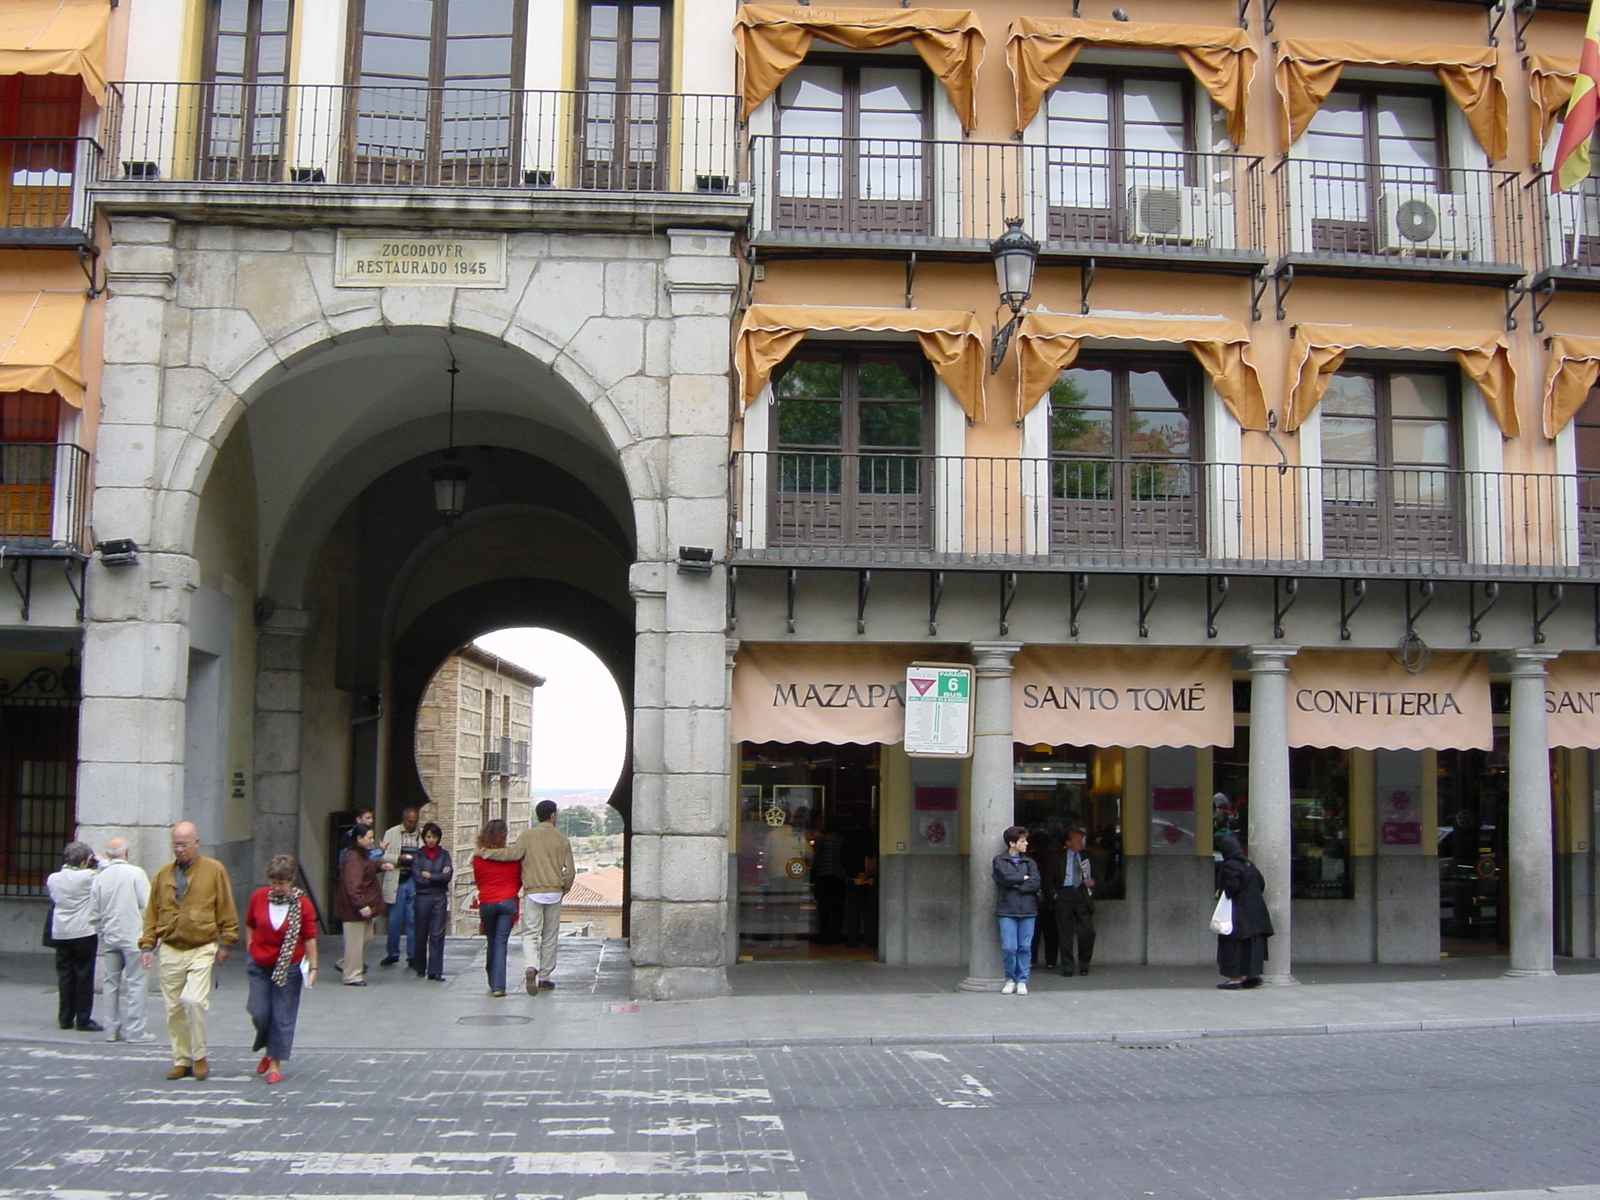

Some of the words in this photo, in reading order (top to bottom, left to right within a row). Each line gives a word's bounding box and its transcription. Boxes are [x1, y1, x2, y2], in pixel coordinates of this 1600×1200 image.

[356, 261, 448, 274] RESTAURADO
[454, 262, 487, 275] 1945
[772, 683, 906, 708] MAZAPA
[948, 678, 958, 691] 6
[1023, 684, 1119, 711] SANTO
[1126, 682, 1206, 711] TOMÉ
[1296, 689, 1464, 716] CONFITERIA
[1544, 690, 1600, 715] SAN
